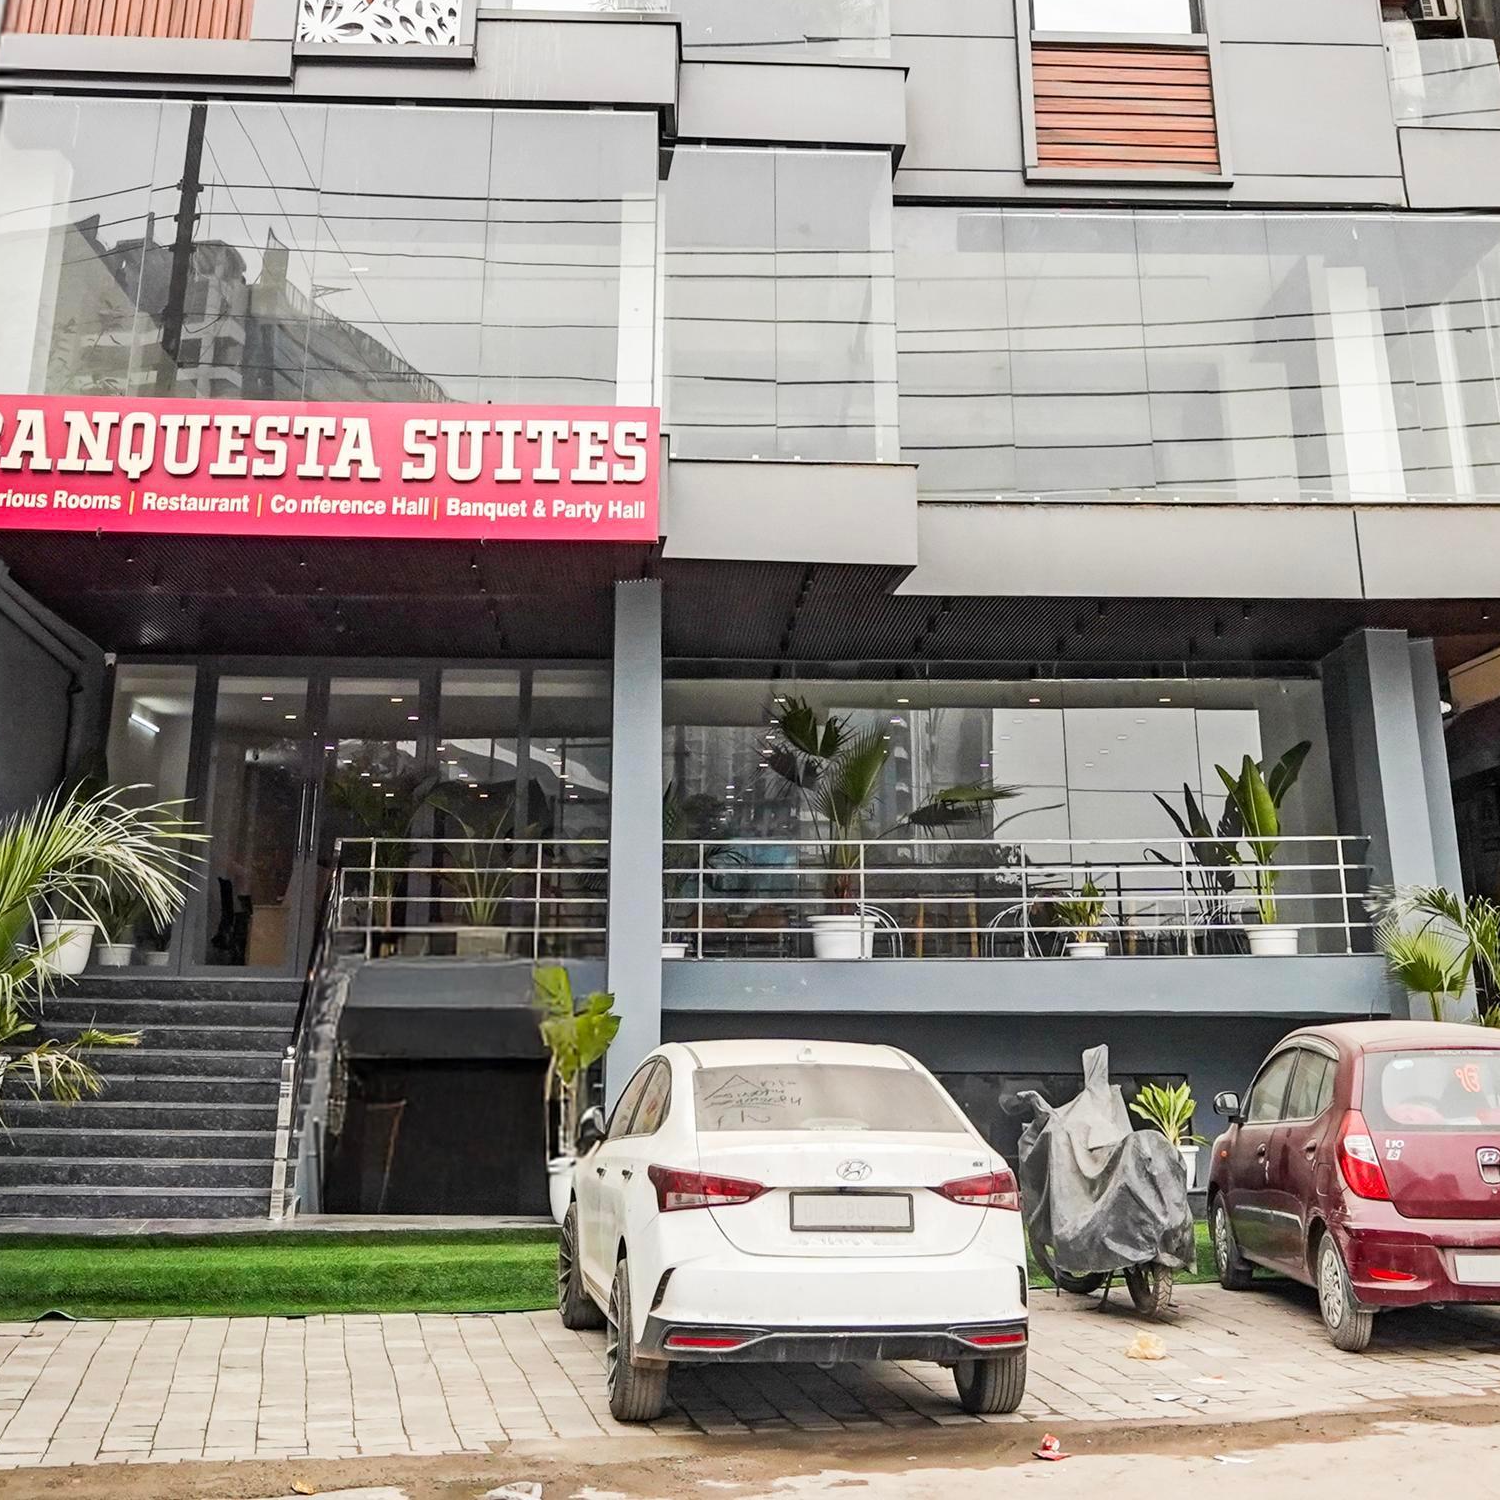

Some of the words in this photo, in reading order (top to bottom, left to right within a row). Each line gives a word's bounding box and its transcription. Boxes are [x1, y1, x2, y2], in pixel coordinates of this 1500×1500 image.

[401, 419, 648, 483] SUITES
[53, 490, 121, 510] Rooms
[142, 492, 250, 513] Restaurant
[391, 496, 430, 516] Hall
[446, 498, 528, 521] Banquet
[532, 499, 547, 518] &
[552, 500, 603, 522] Party
[608, 500, 645, 519] Hall
